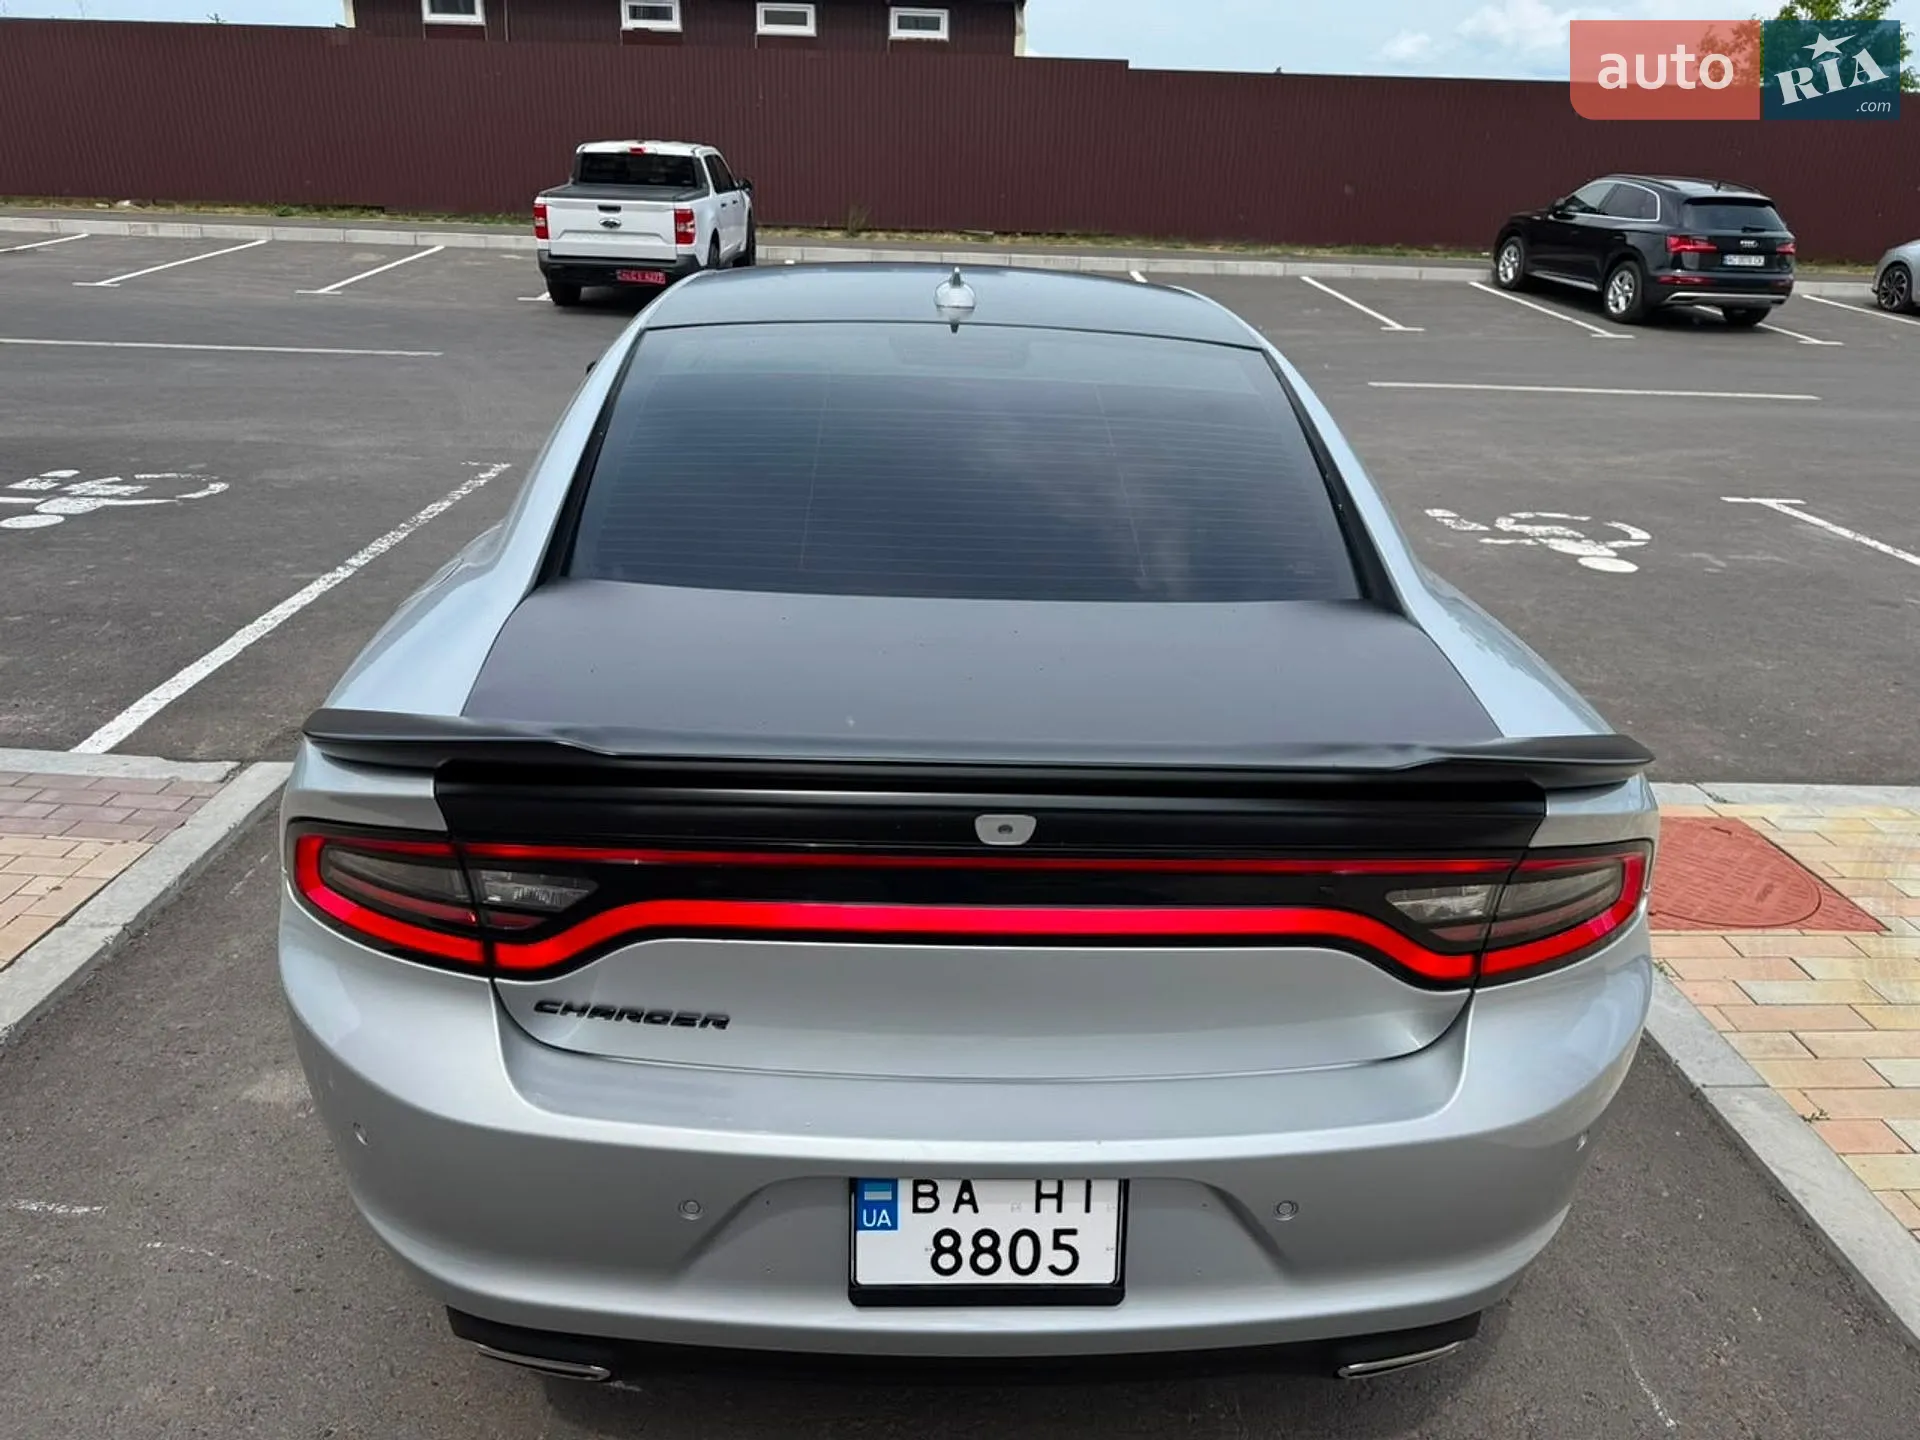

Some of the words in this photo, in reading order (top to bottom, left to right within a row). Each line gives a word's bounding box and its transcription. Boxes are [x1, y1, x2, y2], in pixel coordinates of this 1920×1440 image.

[533, 999, 731, 1031] CHARGER
[911, 1178, 980, 1214] BA
[862, 1209, 892, 1227] UA
[930, 1227, 1080, 1277] 8805
